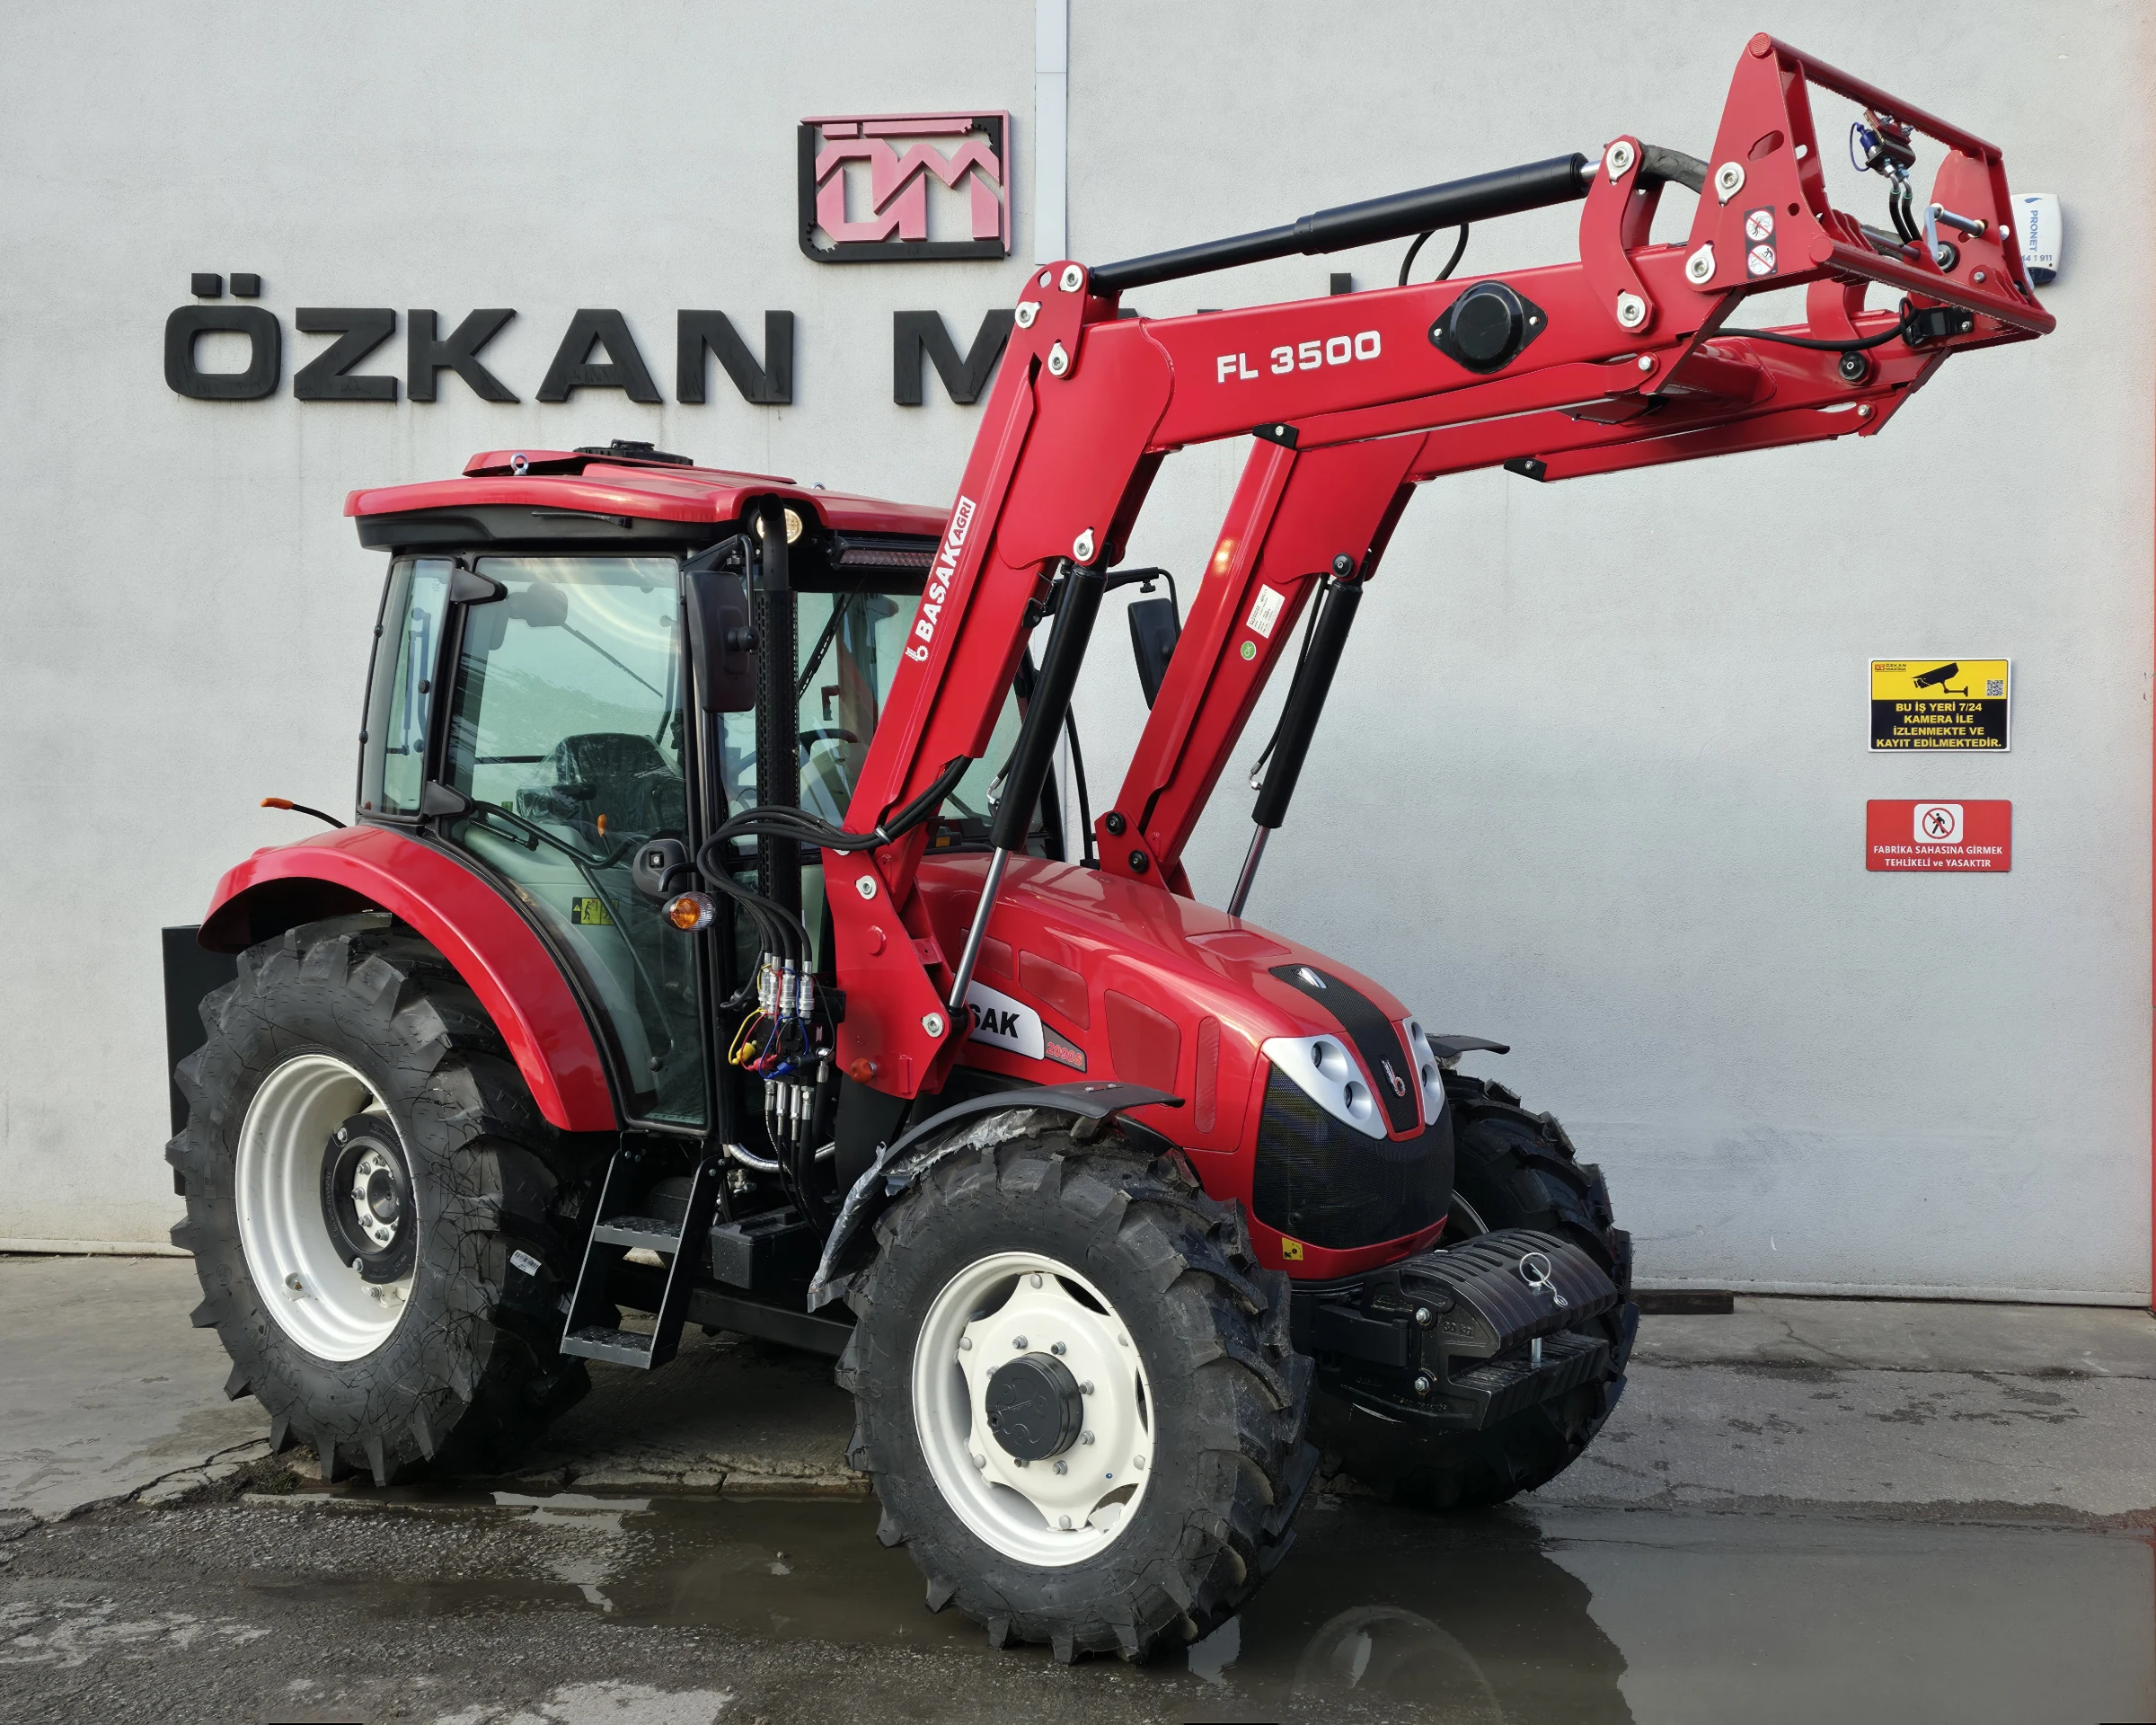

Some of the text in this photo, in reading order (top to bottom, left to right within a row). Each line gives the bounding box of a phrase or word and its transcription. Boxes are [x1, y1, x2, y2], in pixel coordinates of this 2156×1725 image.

[163, 272, 794, 406] ÖZKAN
[1216, 330, 1382, 384] FL 3500
[953, 501, 973, 542] AGRI
[1895, 702, 1982, 713] BU İŞ YERİ 7/24
[1904, 713, 1974, 723] KAMERA İLE
[1894, 726, 1984, 736] İZLENMEKTE VE
[1877, 738, 2001, 748] KAYIT EDİLMEKTEDİR.
[1874, 845, 2002, 854] FABRİKA SAHASINA GİRMEK
[1885, 857, 1931, 867] TEHLİKELİ
[1946, 859, 1991, 867] YASAKTIR
[968, 1003, 1021, 1039] SAK
[1047, 1041, 1083, 1066] 2090S
